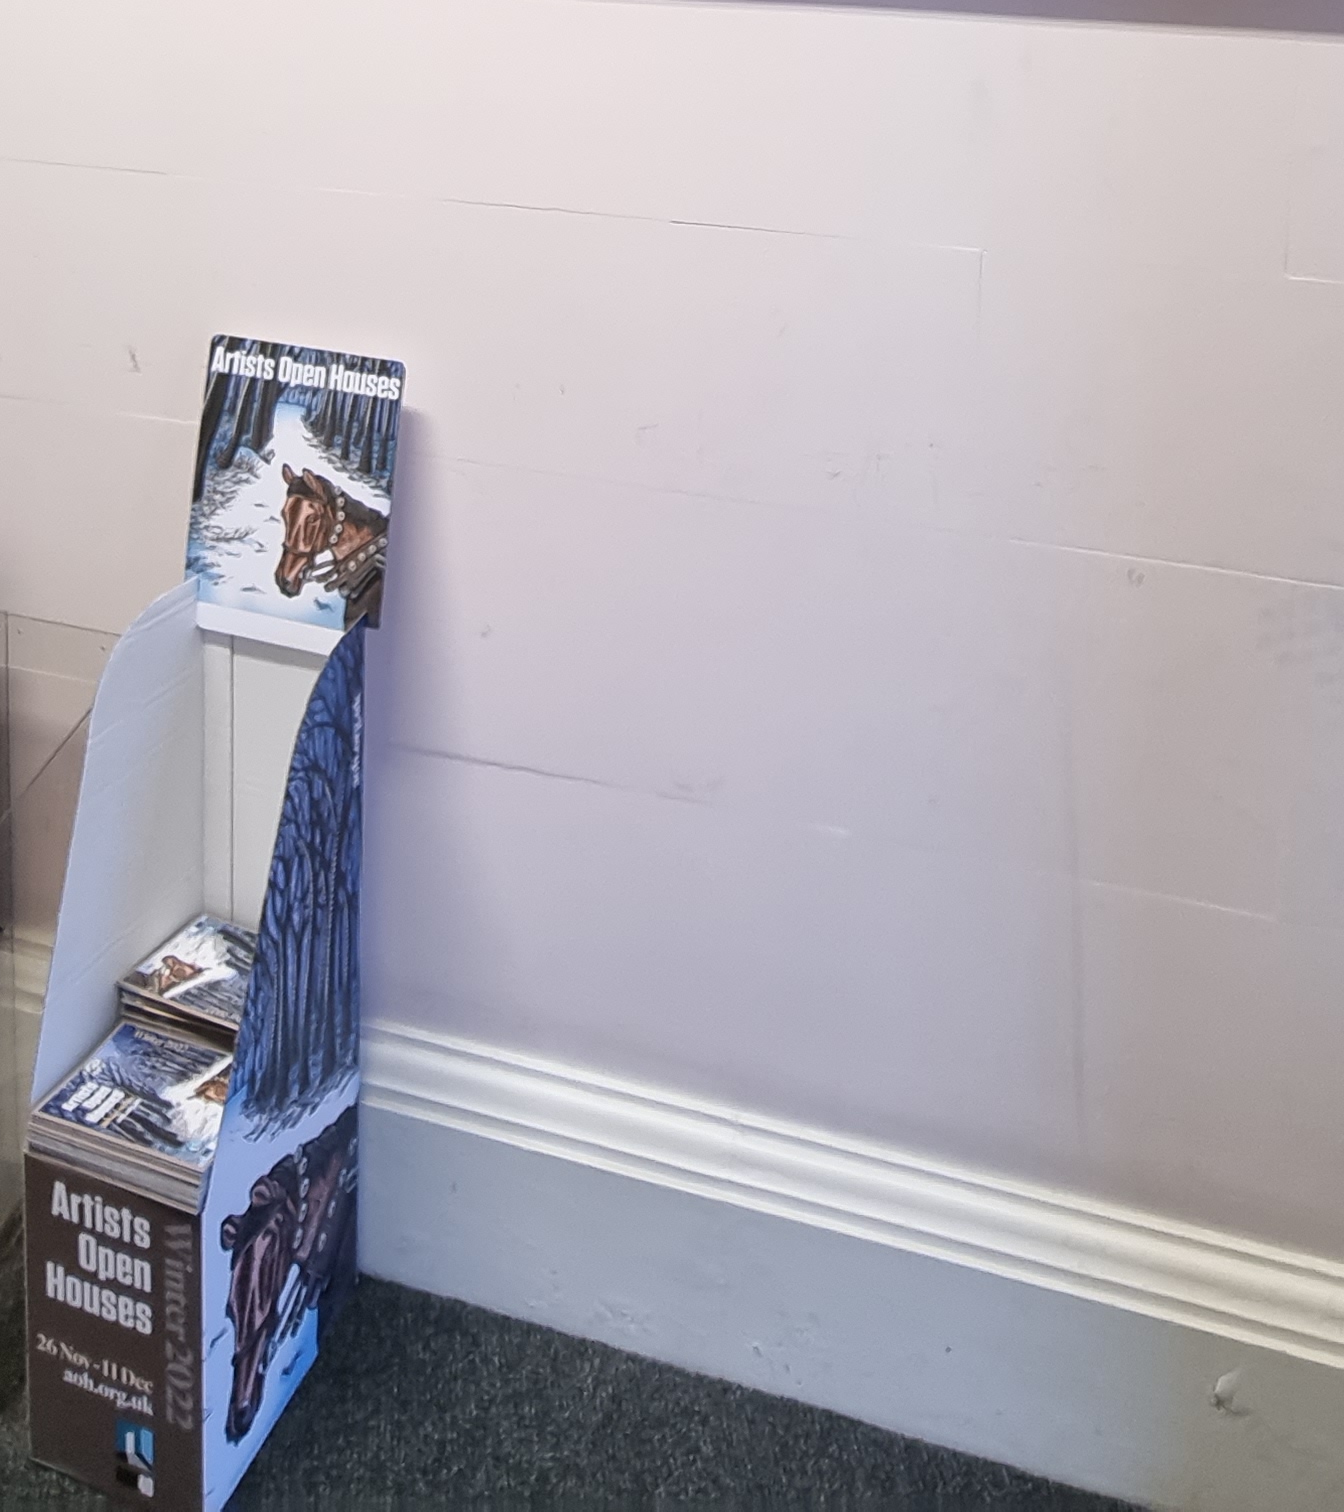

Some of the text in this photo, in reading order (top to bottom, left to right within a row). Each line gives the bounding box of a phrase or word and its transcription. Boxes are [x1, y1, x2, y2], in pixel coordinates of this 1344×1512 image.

[211, 346, 401, 400] Artists Open Houses
[51, 1180, 151, 1250] Artists
[77, 1231, 152, 1294] Open
[45, 1260, 153, 1336] Houses
[164, 1223, 194, 1431] Winter 2022
[36, 1333, 59, 1354] 26
[59, 1341, 91, 1370] Nov
[124, 1370, 154, 1394] Dec
[62, 1368, 154, 1417] aoh.org.uk
